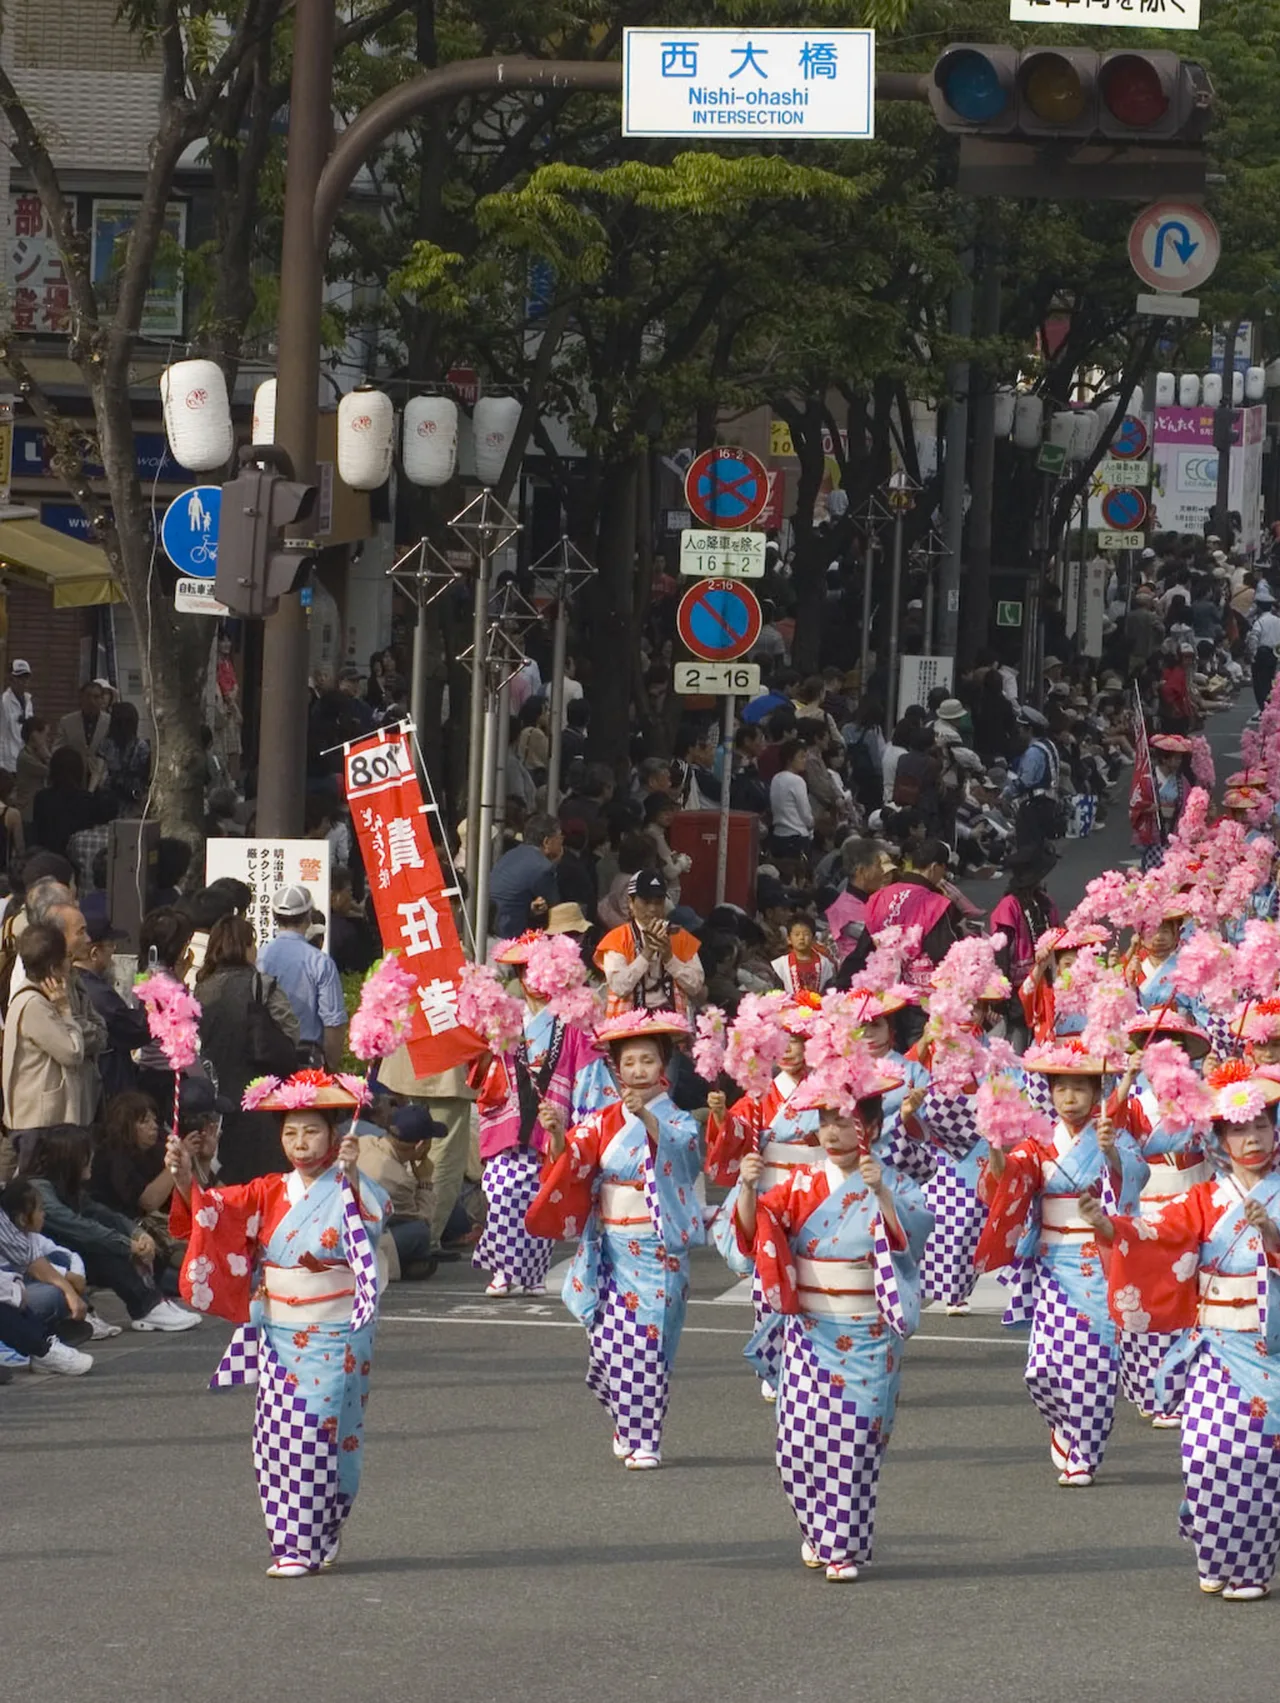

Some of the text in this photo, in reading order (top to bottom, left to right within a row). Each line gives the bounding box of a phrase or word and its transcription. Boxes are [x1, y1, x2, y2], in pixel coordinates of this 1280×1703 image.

[659, 41, 838, 81] 西大橋
[689, 87, 809, 106] Nishi-ohashi
[692, 110, 804, 125] INTERSECTION
[719, 449, 744, 460] 16-2
[684, 534, 763, 553] 人の降車を除く
[1104, 535, 1139, 546] 2-16
[708, 580, 734, 591] 2-16
[685, 669, 749, 688] 2-16
